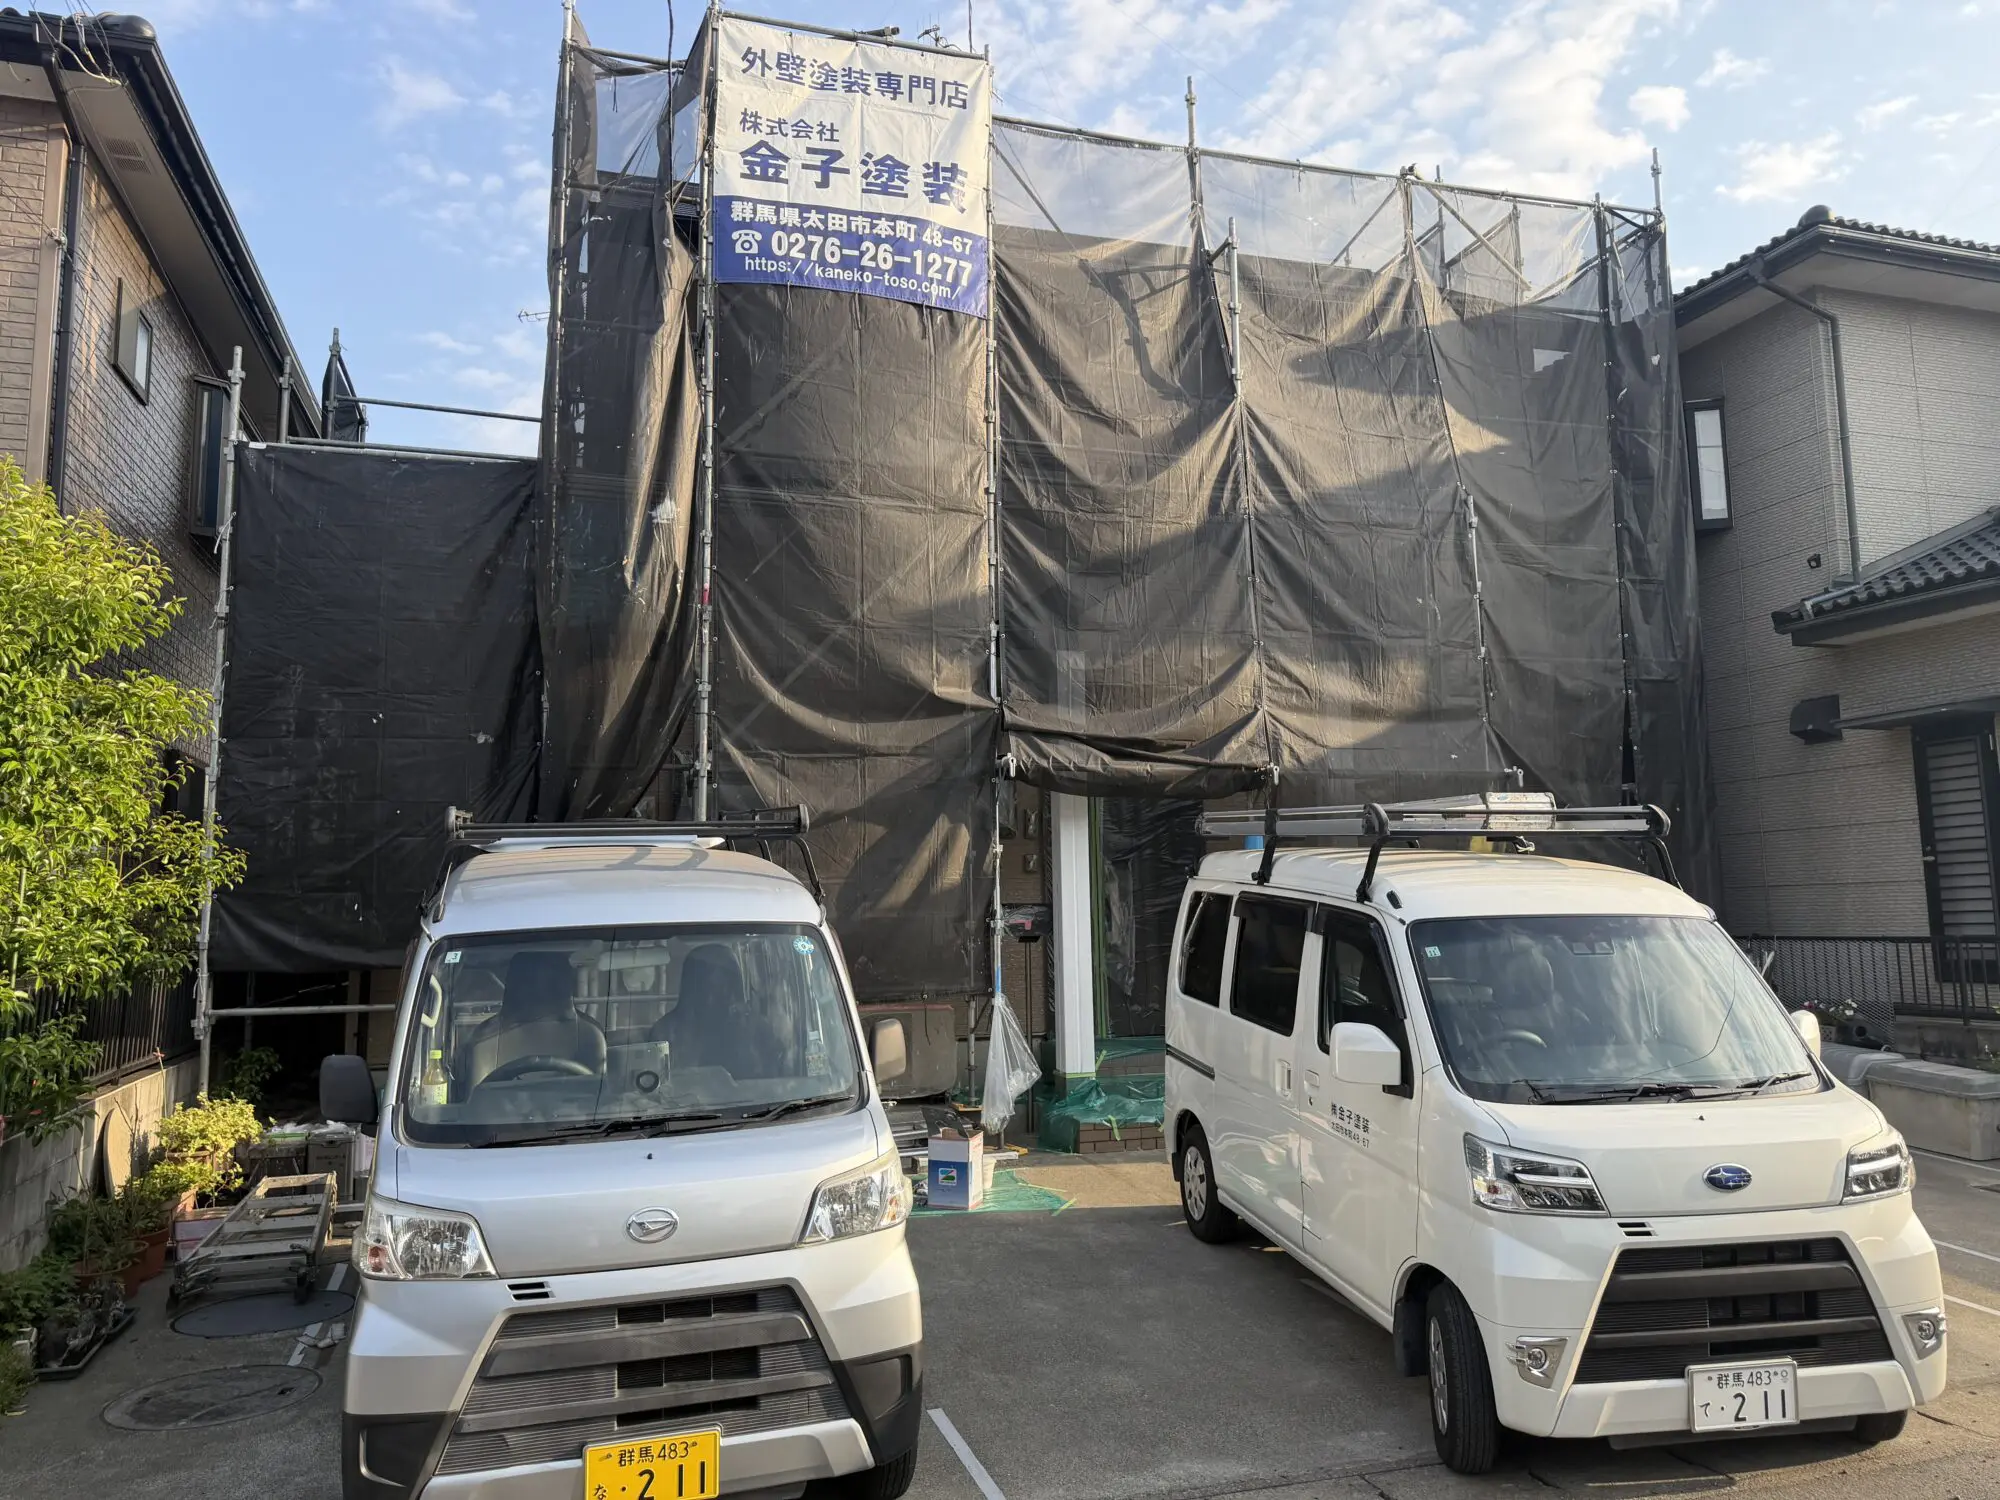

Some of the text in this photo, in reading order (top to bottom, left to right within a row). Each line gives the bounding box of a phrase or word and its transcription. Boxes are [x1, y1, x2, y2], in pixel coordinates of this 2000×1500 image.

[740, 46, 969, 110] 外壁塗装専門店
[739, 107, 840, 142] 株式会社
[739, 140, 968, 214] 金子塗装
[730, 200, 917, 242] 群馬県太田市本町
[745, 256, 961, 300] https://kaneko-toso.com/
[771, 230, 973, 287] 0276-26-1277
[1698, 1402, 1711, 1417] て
[593, 1484, 607, 1500] な
